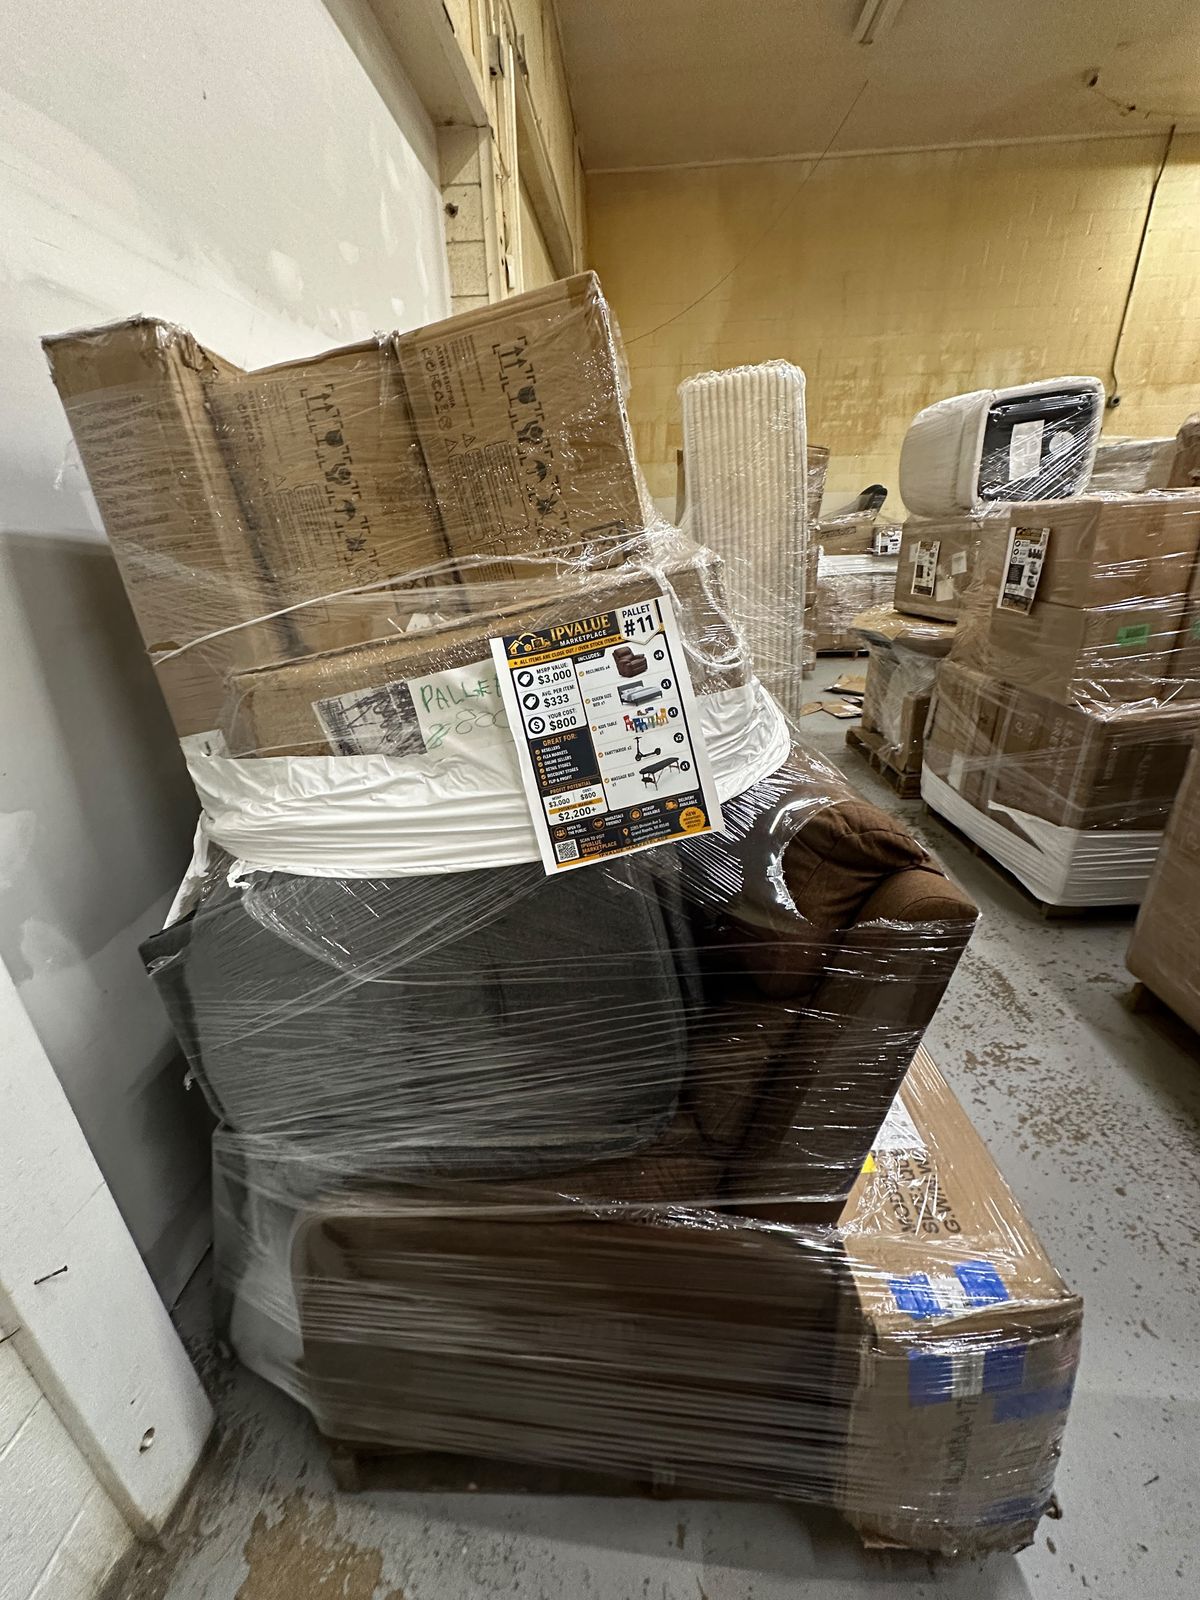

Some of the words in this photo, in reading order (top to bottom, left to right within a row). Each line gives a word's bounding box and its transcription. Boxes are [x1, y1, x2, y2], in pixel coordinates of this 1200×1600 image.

[622, 604, 650, 618] PALLET
[550, 615, 610, 641] IPVALUE
[623, 615, 654, 637] #11
[559, 629, 607, 647] MARKETPLACE
[528, 655, 542, 663] ITEMS
[578, 643, 589, 651] OVER
[590, 640, 603, 648] STOCK
[577, 652, 601, 661] INCLUDES:
[537, 666, 551, 674] MSRP
[552, 662, 568, 670] VALUE:
[537, 668, 572, 686] $3,000
[563, 684, 575, 692] ITEM:
[543, 692, 570, 708] $333
[562, 708, 577, 716] COST:
[549, 715, 577, 731] $800
[542, 736, 562, 746] GREAT
[563, 733, 577, 741] FOR:
[550, 786, 566, 794] PROFIT
[567, 780, 591, 790] POTENTIAL
[580, 791, 596, 800] $800
[558, 804, 597, 822] $2,200+
[582, 841, 617, 854] MARKETPLACE
